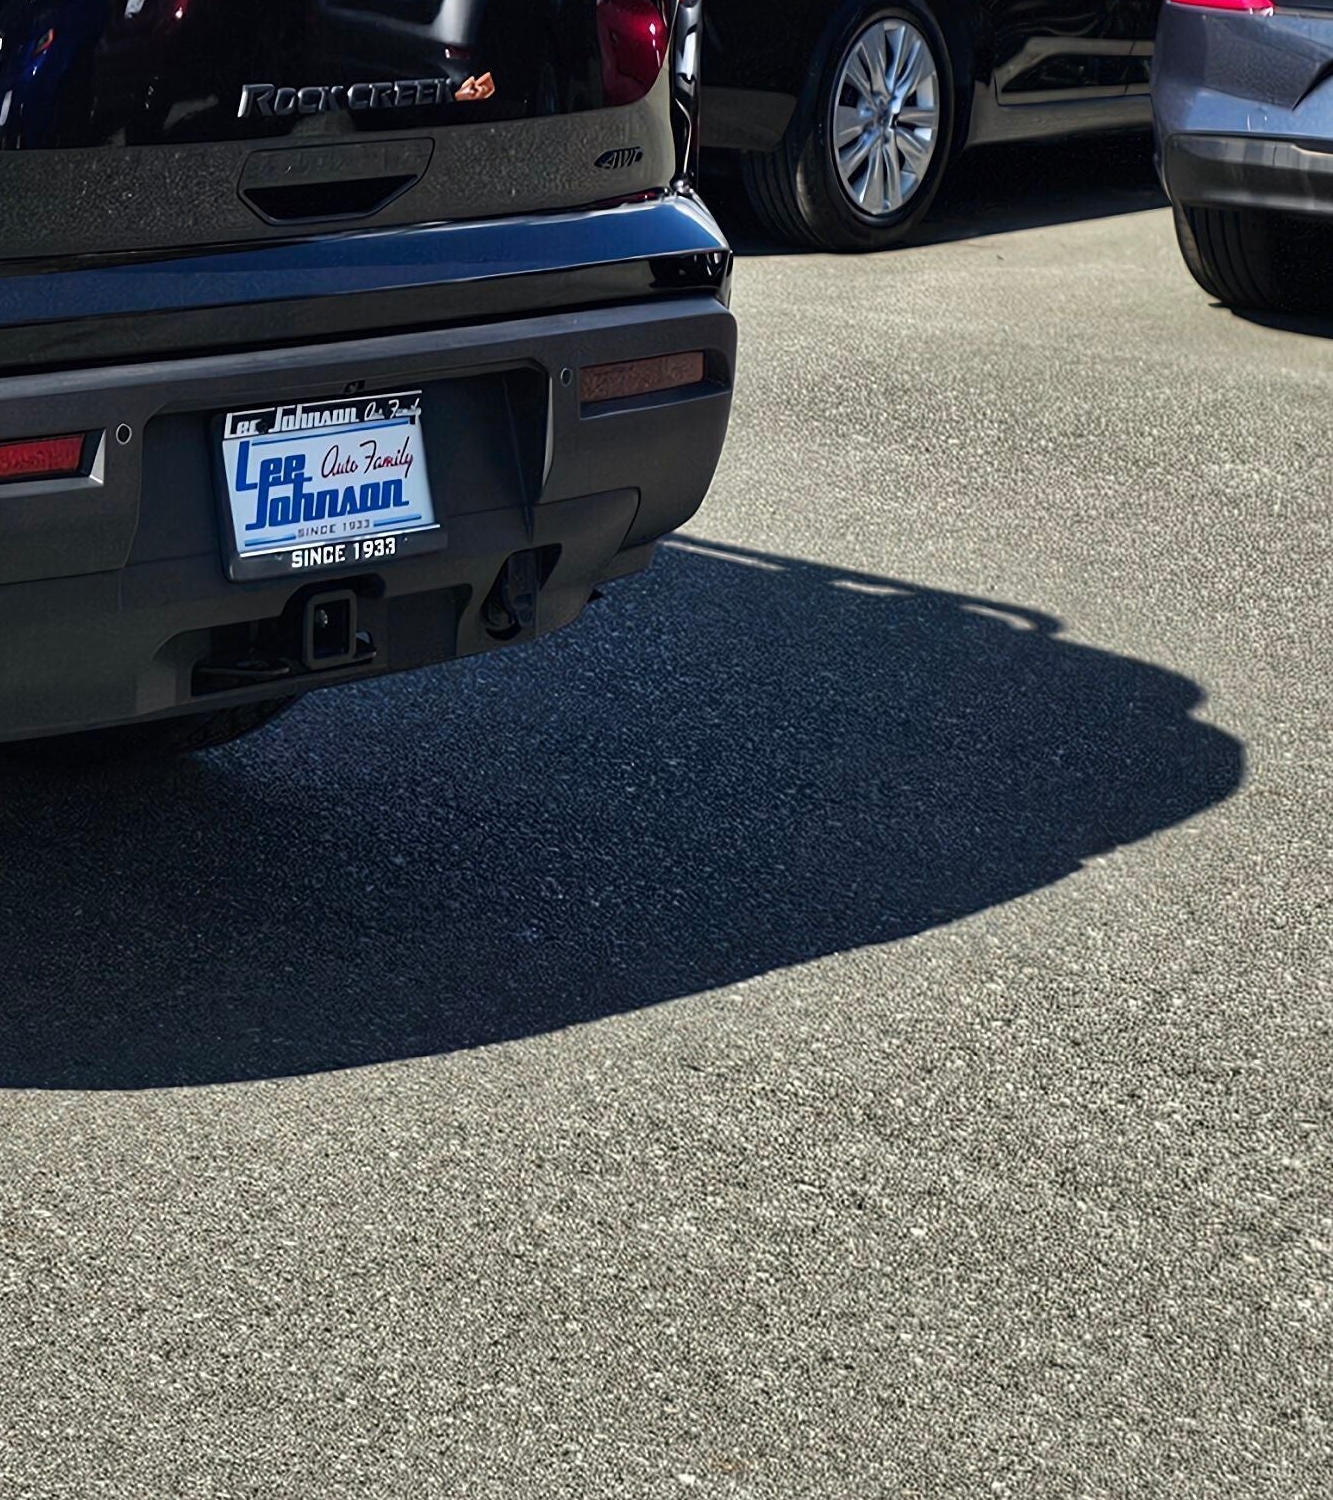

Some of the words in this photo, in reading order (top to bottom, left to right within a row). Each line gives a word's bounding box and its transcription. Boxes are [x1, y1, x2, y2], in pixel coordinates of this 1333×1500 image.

[237, 83, 343, 118] ROCK
[347, 77, 454, 110] CREEK
[268, 405, 360, 434] Johnson
[236, 441, 309, 492] Lee
[321, 445, 359, 478] Auto
[359, 436, 413, 478] Family
[245, 472, 409, 531] Johnson
[297, 524, 336, 538] SINCE
[342, 519, 371, 532] 1933
[292, 544, 346, 568] SINCE
[353, 537, 396, 561] 1933
